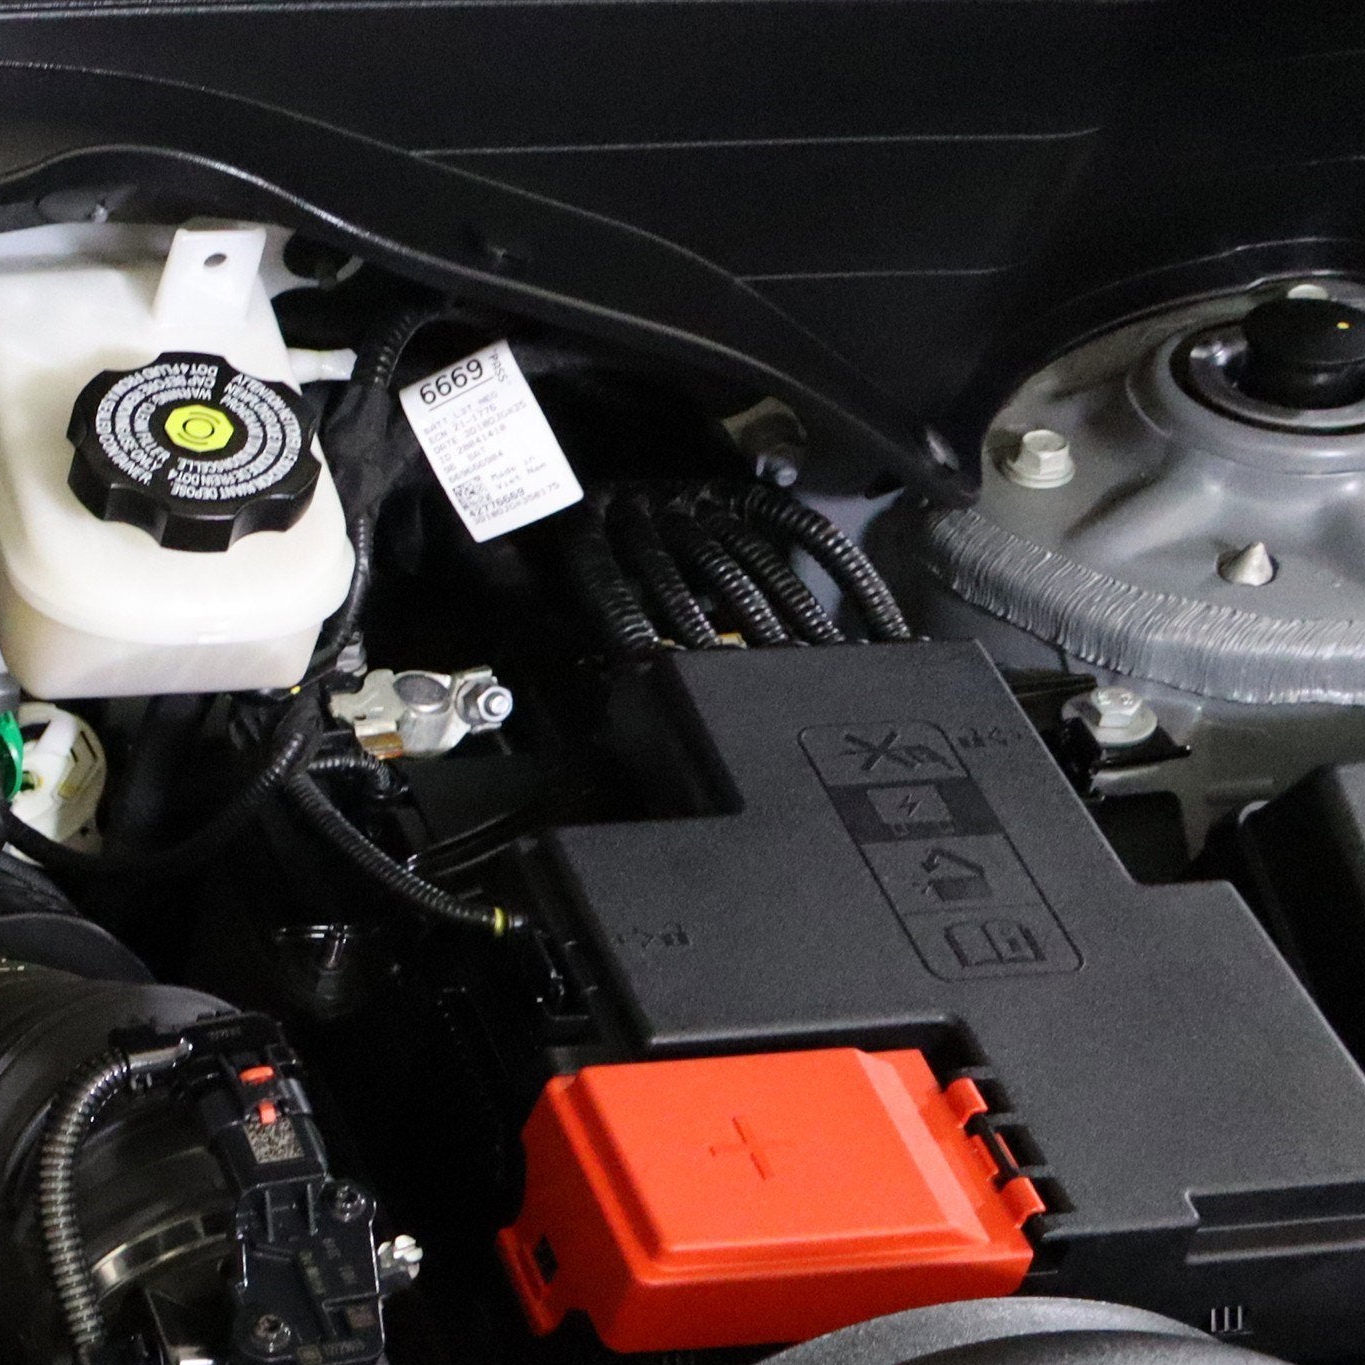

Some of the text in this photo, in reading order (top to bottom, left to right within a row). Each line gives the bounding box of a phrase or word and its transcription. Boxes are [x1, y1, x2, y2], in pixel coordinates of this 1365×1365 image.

[139, 363, 179, 380] FLUID
[188, 363, 218, 377] DOT
[109, 371, 146, 396] FROM
[137, 374, 186, 395] BEFORE
[186, 374, 216, 388] CAP
[420, 358, 483, 404] 6669
[96, 397, 116, 433] SEALED
[126, 449, 162, 472] ONLY
[134, 433, 173, 467] FILLER
[201, 472, 236, 485] FREIN
[217, 481, 258, 499] AVANT
